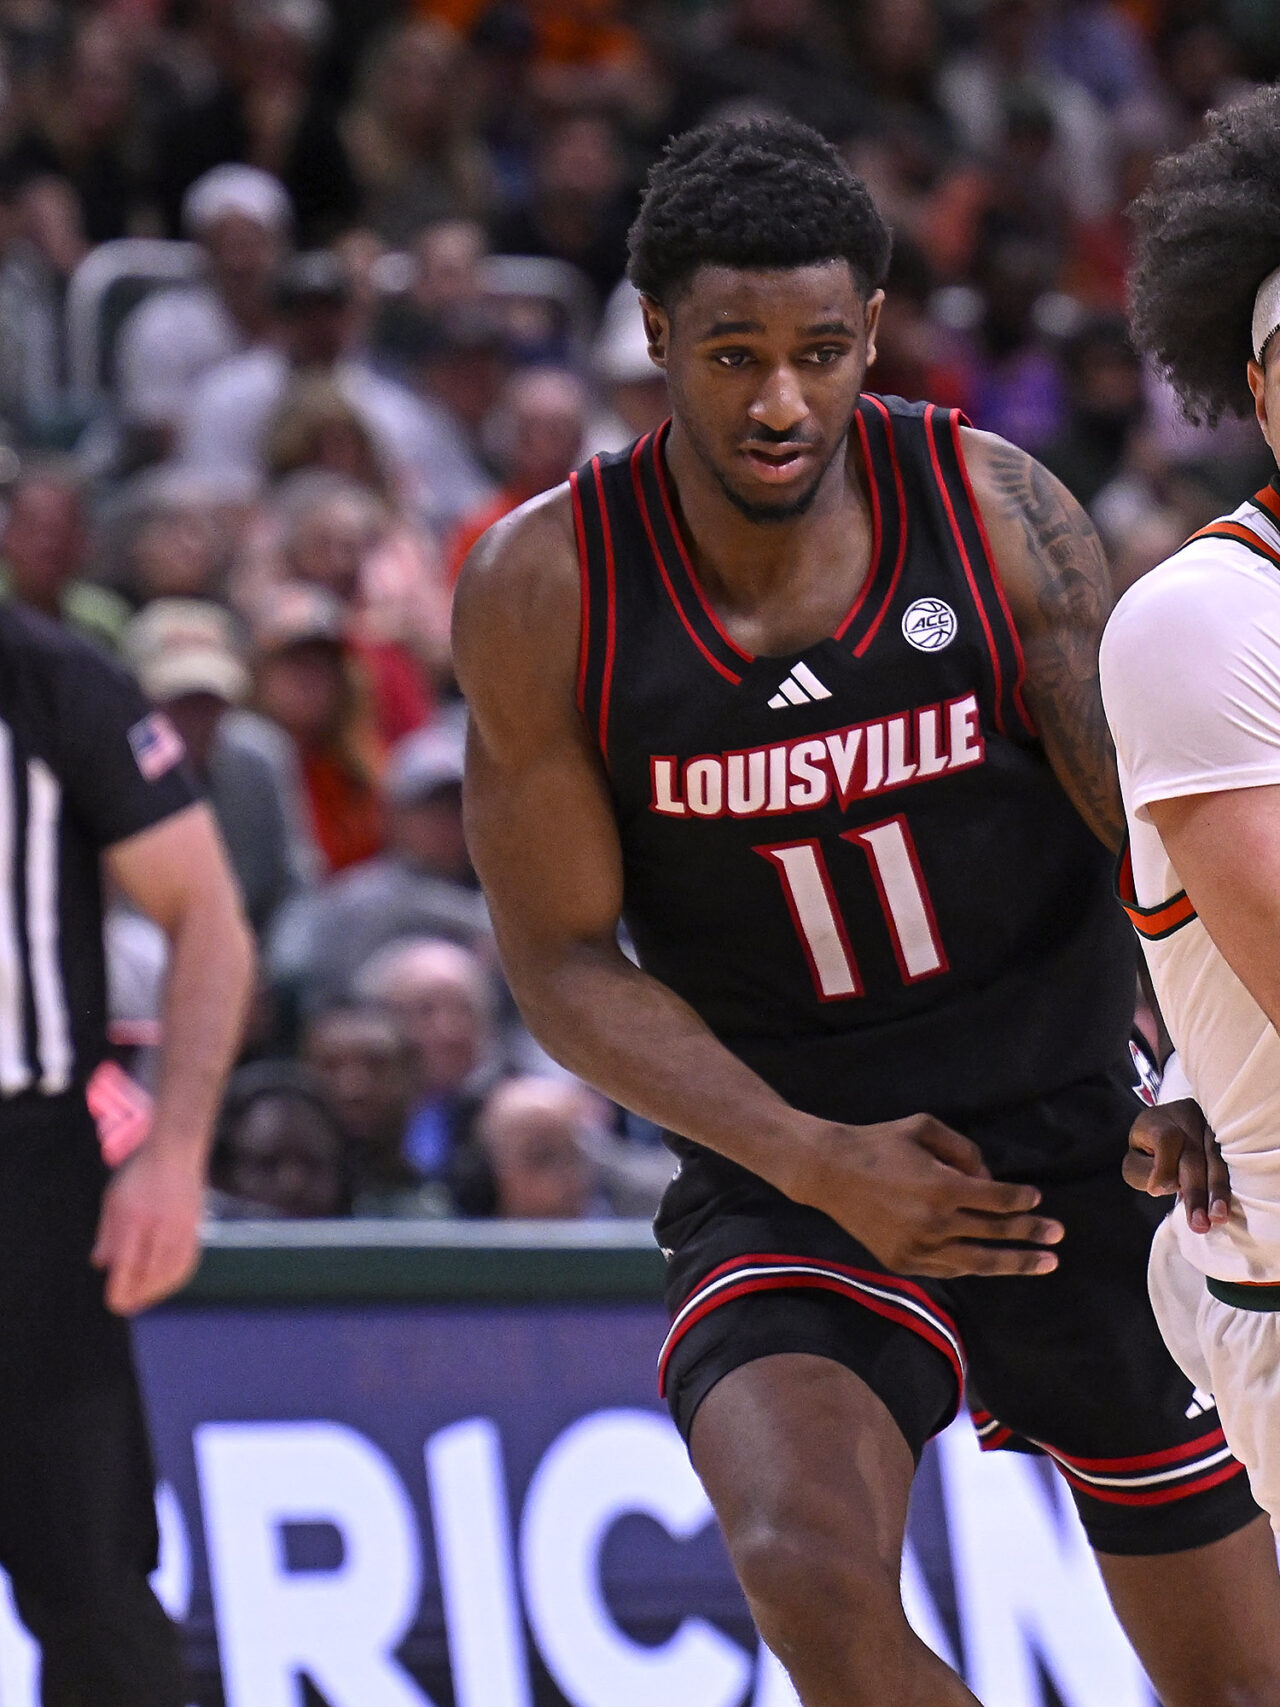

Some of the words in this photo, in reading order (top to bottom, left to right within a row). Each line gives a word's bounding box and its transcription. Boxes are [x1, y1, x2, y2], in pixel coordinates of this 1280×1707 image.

[911, 611, 949, 631] ACC
[649, 690, 985, 819] LOUISVILLE
[752, 813, 949, 1003] 11
